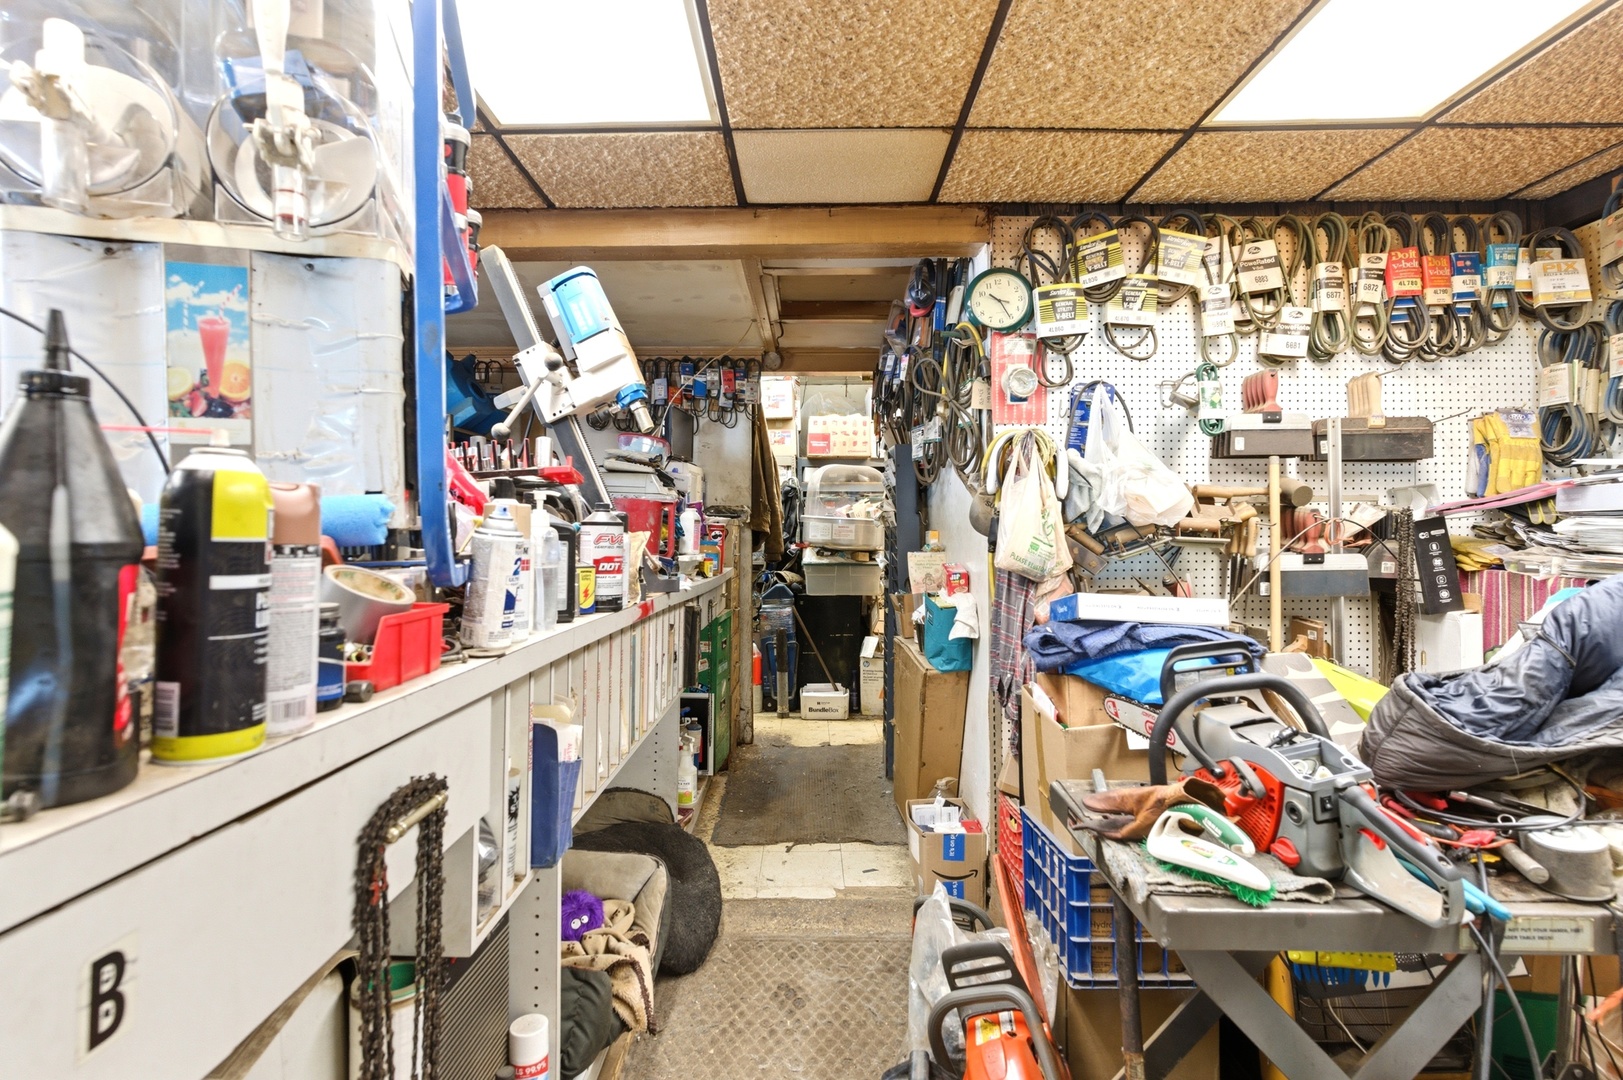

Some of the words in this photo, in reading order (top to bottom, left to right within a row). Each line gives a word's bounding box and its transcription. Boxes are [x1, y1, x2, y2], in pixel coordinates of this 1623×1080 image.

[1088, 261, 1108, 272] V-BELT
[1164, 259, 1184, 268] V-BELT
[1392, 260, 1419, 268] v-belt
[1543, 261, 1578, 272] PIX
[1428, 267, 1450, 276] v-belt
[1010, 551, 1028, 565] PLEASE
[598, 562, 620, 571] DOT
[88, 950, 126, 1052] B
[525, 1060, 547, 1075] 99.9%
